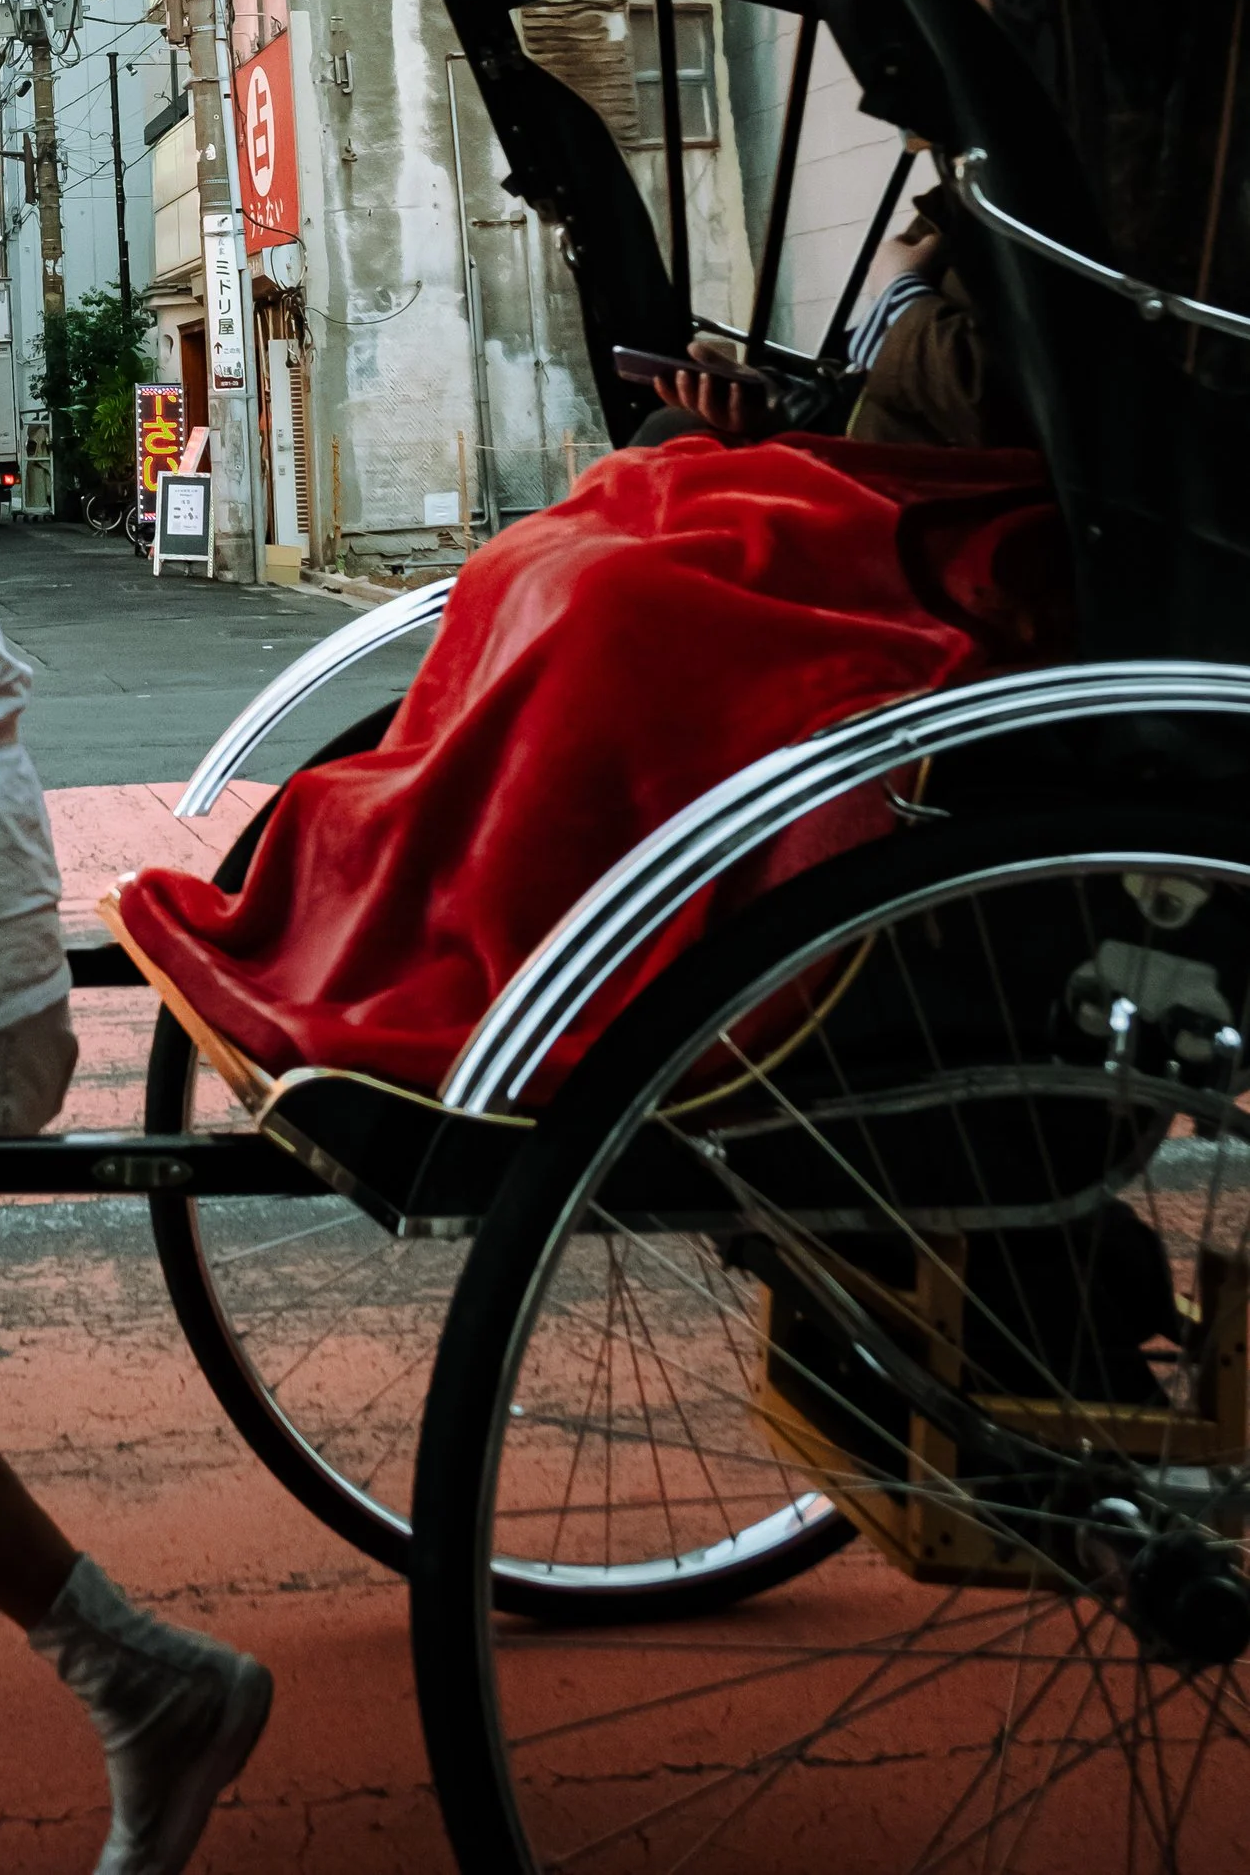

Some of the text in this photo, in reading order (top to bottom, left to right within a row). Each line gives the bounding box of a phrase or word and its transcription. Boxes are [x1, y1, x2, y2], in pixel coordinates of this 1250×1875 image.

[250, 197, 283, 239] うらない
[216, 260, 235, 335] ミドリ屋
